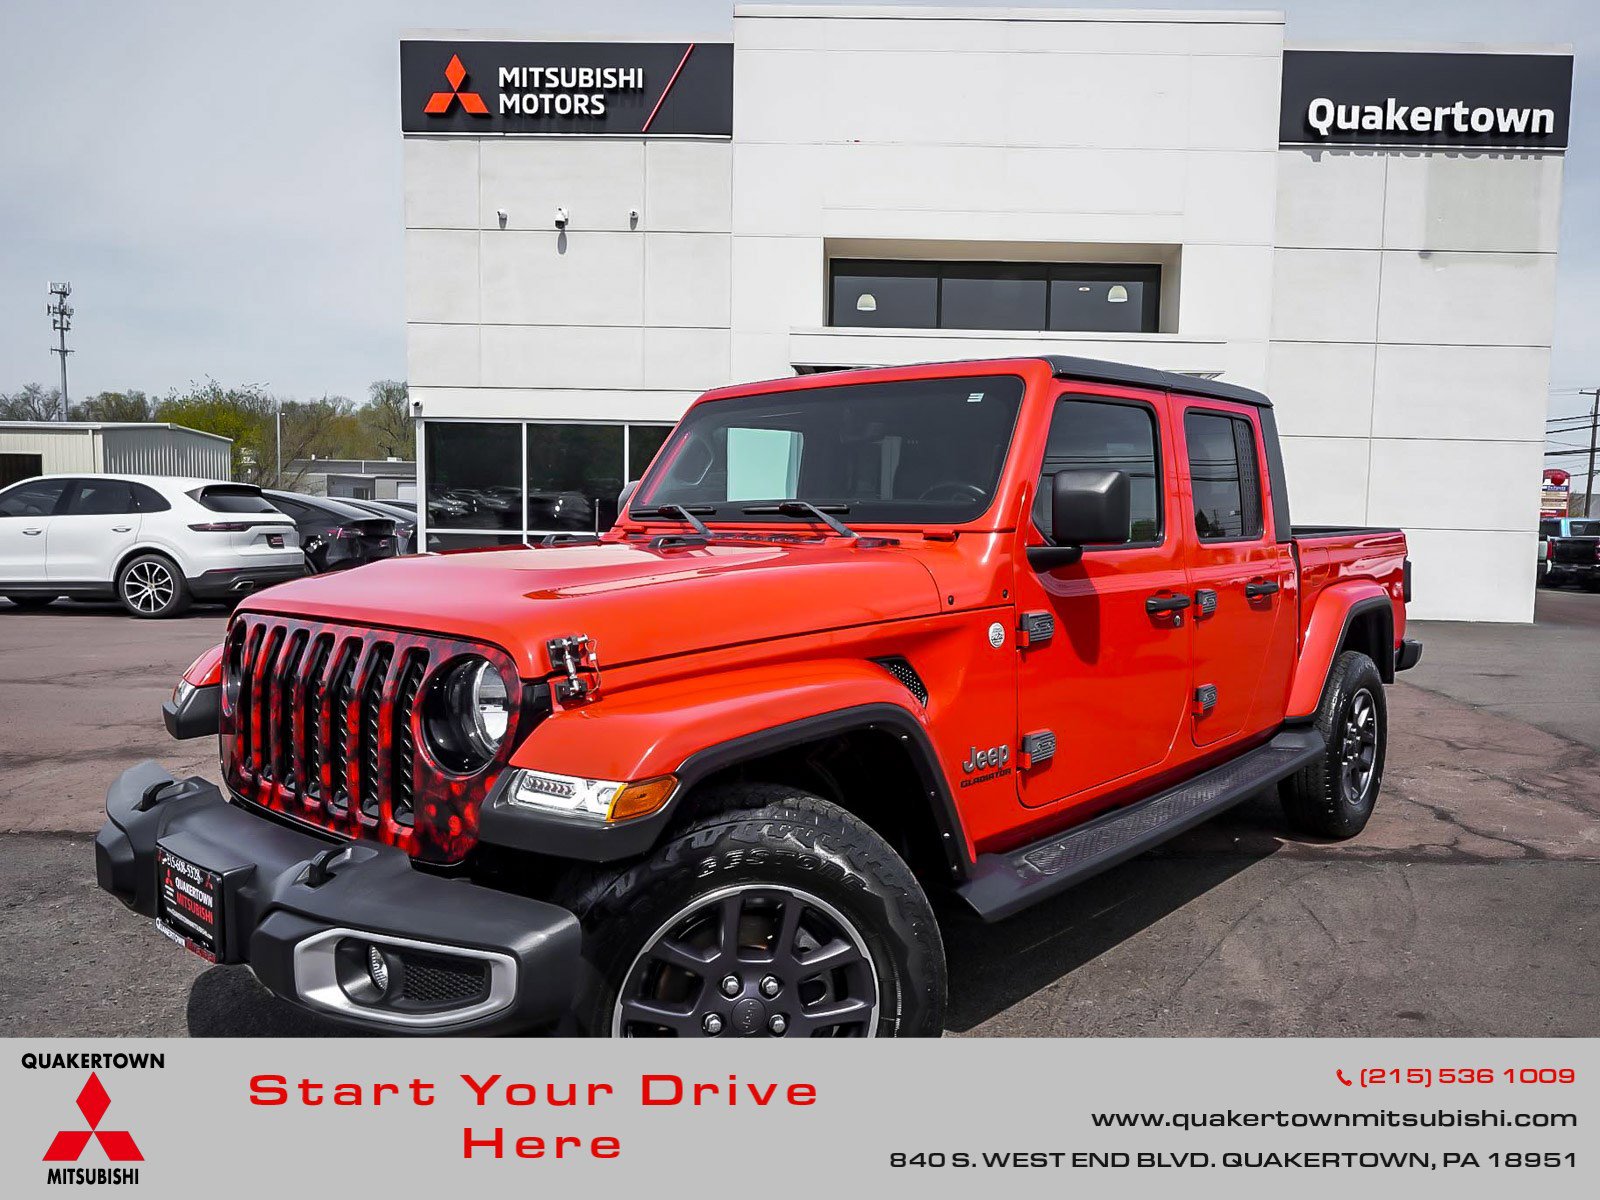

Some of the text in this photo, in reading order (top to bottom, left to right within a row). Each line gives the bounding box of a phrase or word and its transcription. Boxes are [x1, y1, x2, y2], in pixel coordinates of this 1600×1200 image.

[498, 67, 643, 89] MITSUBISHI
[499, 93, 605, 115] MOTORS
[1307, 97, 1555, 136] Quakertown
[962, 744, 1010, 773] Jeep
[960, 768, 1012, 788] GLADIATOR
[175, 877, 213, 908] QUAKERTOWN
[176, 892, 214, 925] MITSUBISHI
